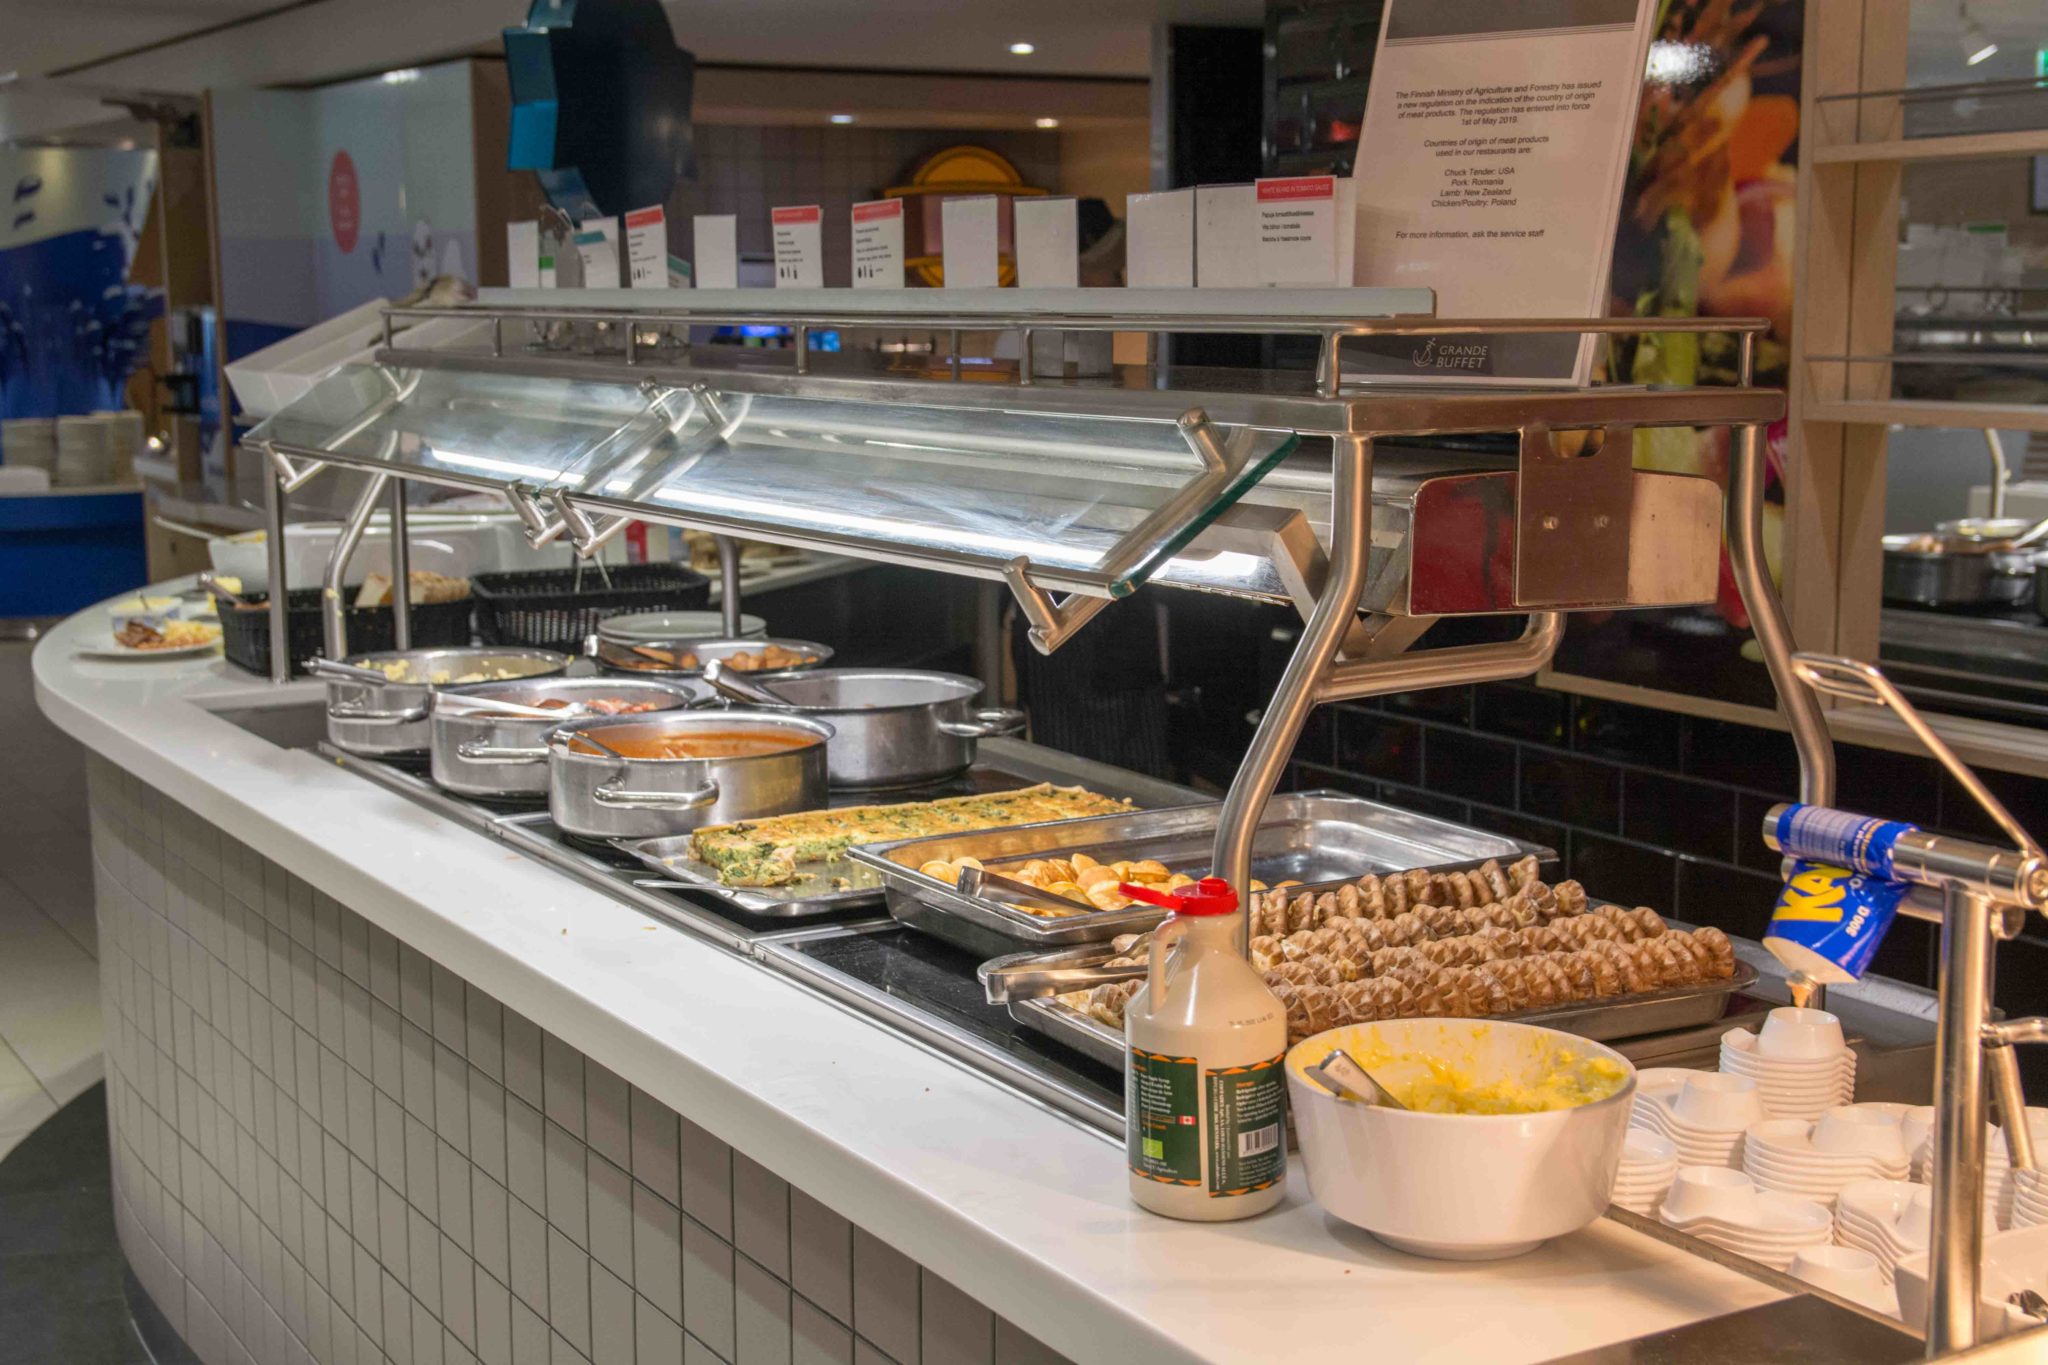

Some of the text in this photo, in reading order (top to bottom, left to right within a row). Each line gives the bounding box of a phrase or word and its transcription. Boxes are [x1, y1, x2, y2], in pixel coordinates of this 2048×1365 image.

[1396, 80, 1602, 99] The Finnish Ministry of Agriculture and Forestry has issued
[1419, 100, 1454, 109] regulation
[1479, 96, 1513, 104] indication
[1514, 95, 1522, 103] of
[1536, 93, 1564, 102] country
[1565, 92, 1574, 100] of
[1574, 92, 1595, 101] origin
[1398, 111, 1406, 119] of
[1460, 108, 1473, 116] The
[1474, 106, 1510, 116] regulation
[1526, 104, 1555, 112] entered
[1571, 102, 1591, 110] force
[1462, 118, 1472, 126] 1st
[1473, 117, 1481, 125] of
[1482, 117, 1498, 126] May
[1423, 135, 1550, 147] Countries of origin of meat products
[1435, 149, 1453, 157] used
[1455, 148, 1462, 156] in
[1476, 147, 1516, 156] restaurants
[1444, 167, 1515, 176] Chuck Tender: USA
[1451, 178, 1504, 186] Pork: Romania
[1464, 188, 1481, 196] New
[1481, 187, 1512, 196] Zealand
[1491, 197, 1518, 206] Poland
[1395, 231, 1409, 239] For
[1472, 229, 1485, 238] ask
[1487, 229, 1499, 238] the
[1500, 229, 1526, 238] service
[1528, 228, 1545, 238] staff
[1439, 345, 1488, 356] GRANDE
[1436, 357, 1485, 368] BUFFET
[1772, 862, 1853, 923] KA
